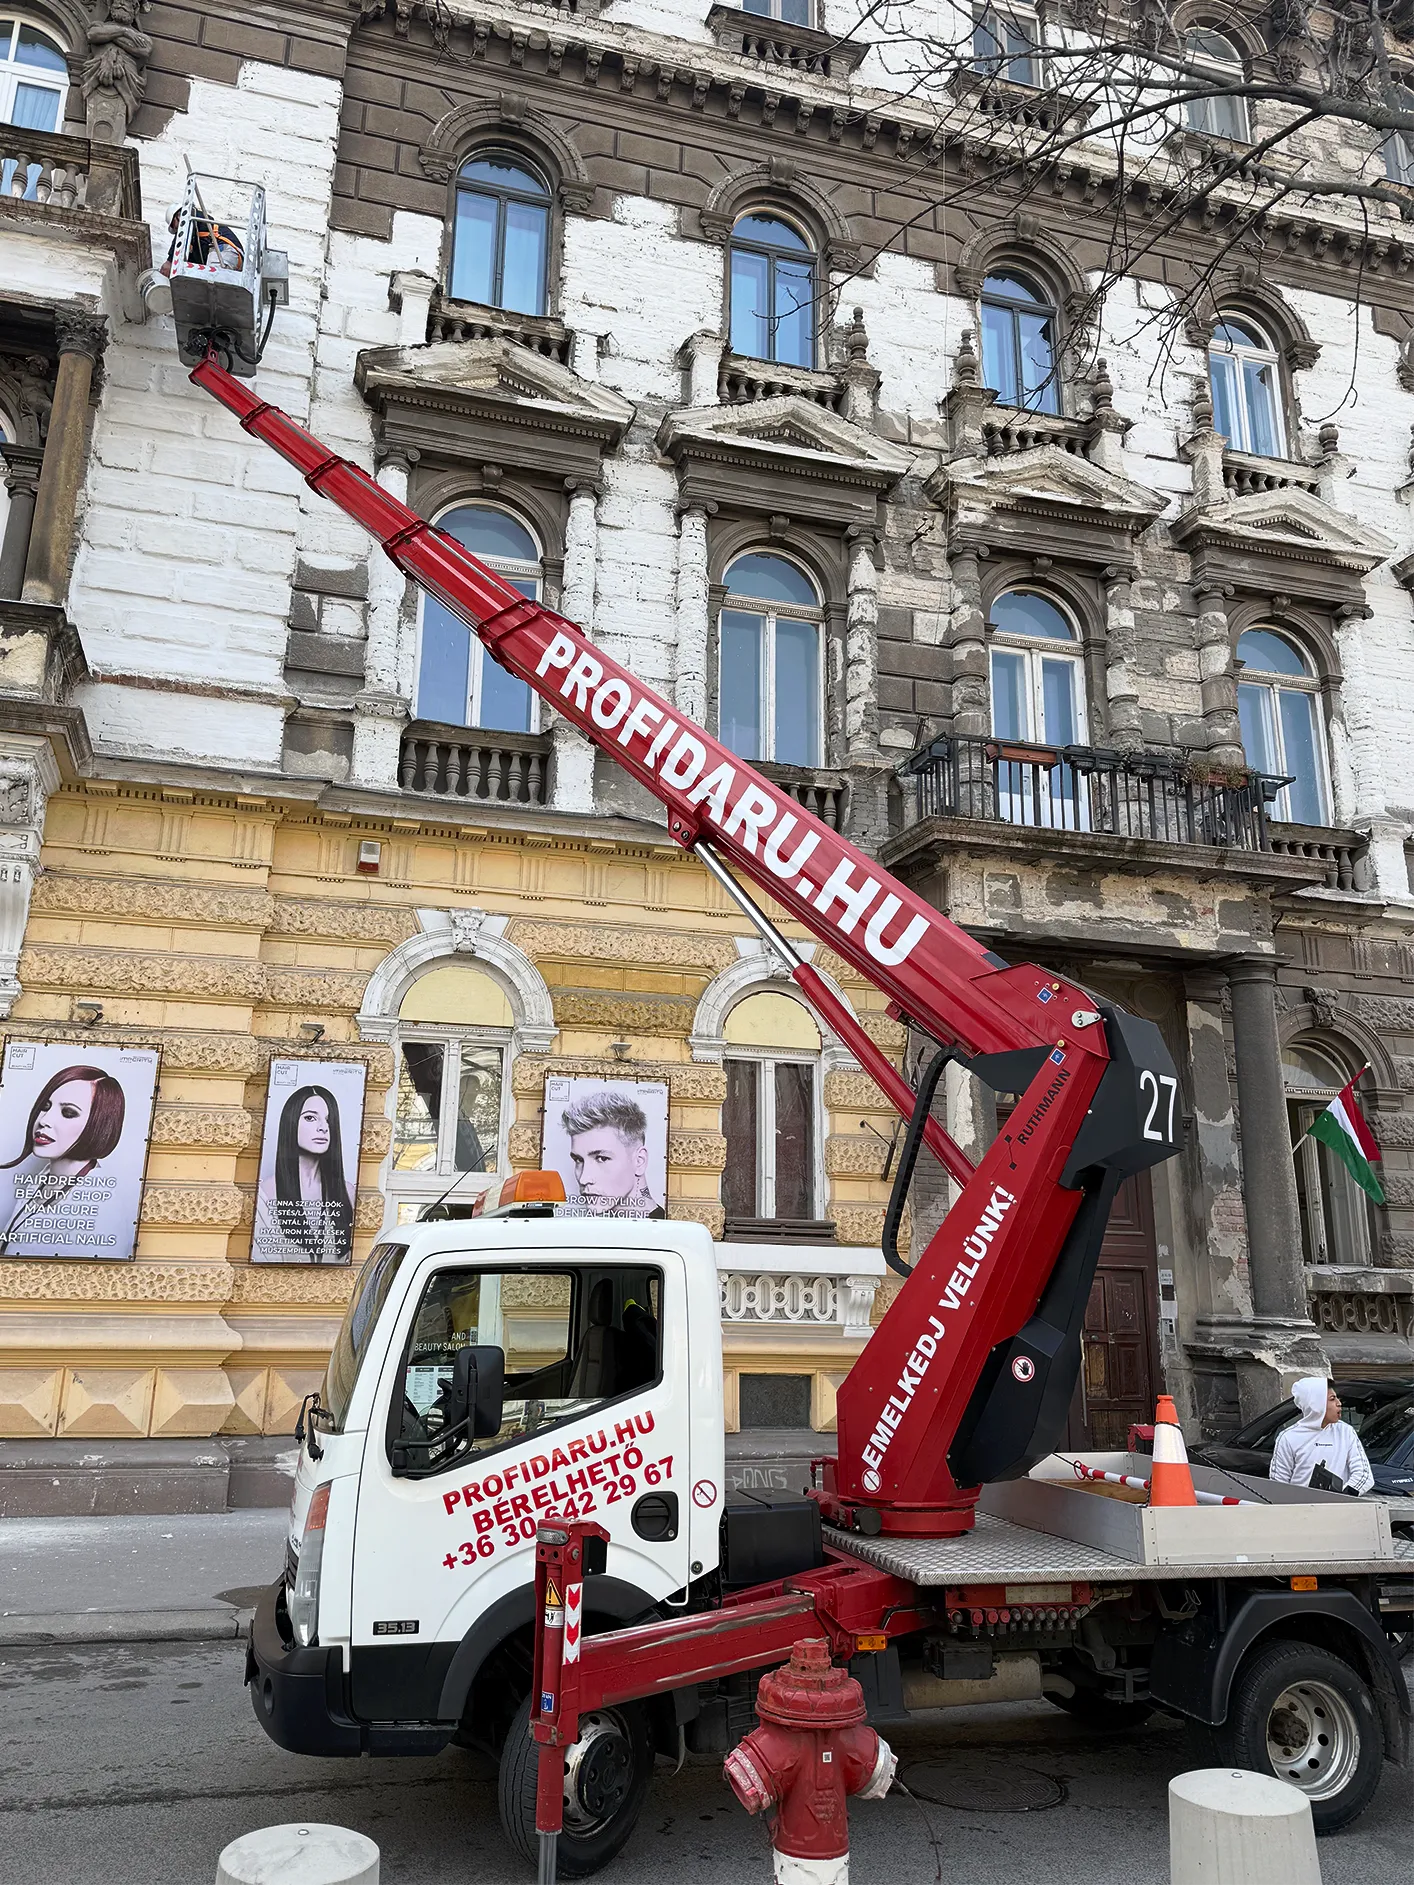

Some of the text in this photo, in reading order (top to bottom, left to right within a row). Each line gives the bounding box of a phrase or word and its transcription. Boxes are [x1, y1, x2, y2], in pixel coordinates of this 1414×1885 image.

[534, 632, 930, 967] PROFIDARU.HU
[1017, 1068, 1071, 1145] RUTHMANN
[1140, 1070, 1177, 1143] 27
[14, 1174, 117, 1188] HAIRDRESSING
[15, 1189, 112, 1201] BEAUTY SHOP
[600, 1196, 645, 1207] STYLING
[24, 1204, 99, 1216] MANICURE
[556, 1208, 650, 1219] DENTAL HYGIENE
[24, 1218, 95, 1230] PEDICURE
[271, 1218, 301, 1226] DENTÁL
[0, 1232, 117, 1246] ARTIFICIAL NAILS
[257, 1237, 303, 1245] KOZMETIKAI
[861, 1185, 1016, 1471] EMELKEDJ VELÜNK!
[452, 1332, 466, 1340] AND
[415, 1343, 442, 1351] BEAUTY
[442, 1410, 656, 1516] PROFIDARU.HU
[472, 1441, 644, 1535] BÉRELHETŐ
[442, 1534, 495, 1570] +36
[501, 1518, 537, 1547] 30
[602, 1474, 637, 1505] 29
[643, 1455, 675, 1486] 67
[377, 1622, 416, 1633] 35.13
